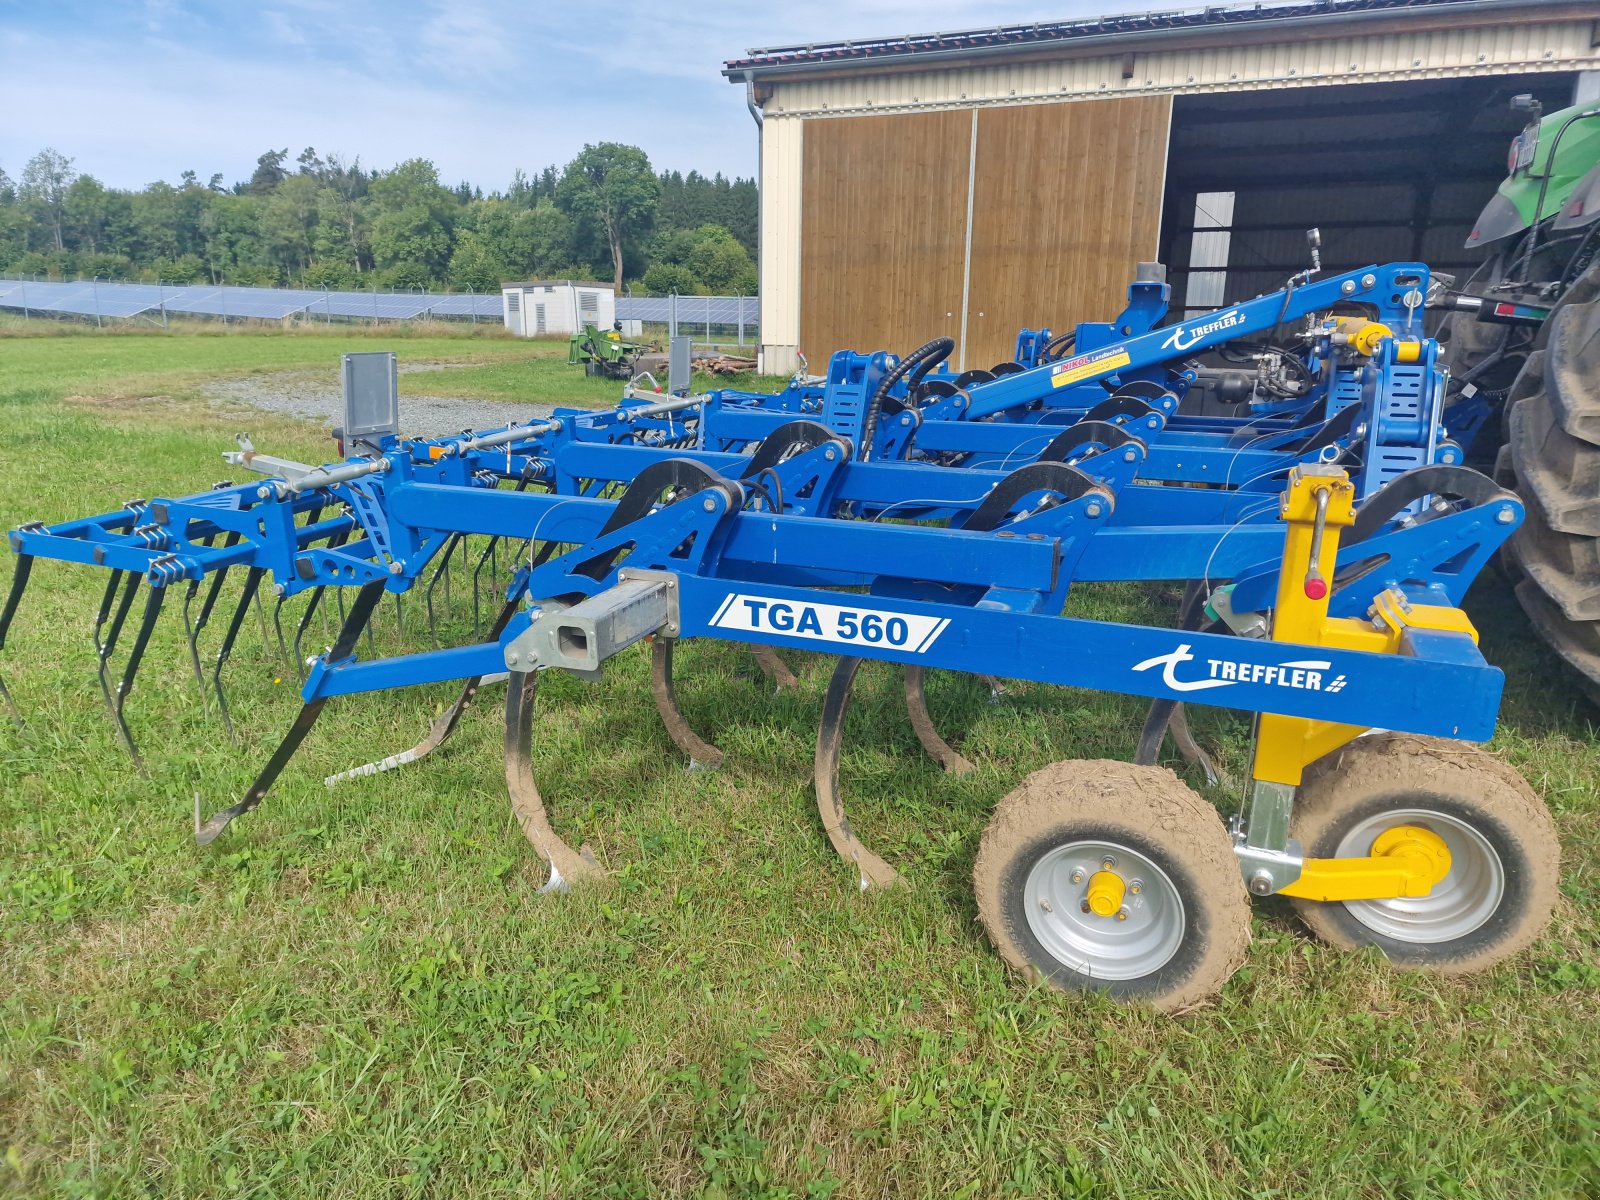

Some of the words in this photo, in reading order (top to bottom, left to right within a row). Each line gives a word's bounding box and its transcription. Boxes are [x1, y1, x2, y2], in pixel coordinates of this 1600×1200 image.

[1190, 317, 1237, 338] TREFFLER
[1062, 357, 1088, 371] NIKOL
[1091, 347, 1125, 361] Landtechnik
[744, 600, 823, 635] TGA
[837, 611, 909, 645] 560
[1207, 659, 1322, 691] TREFFLER
